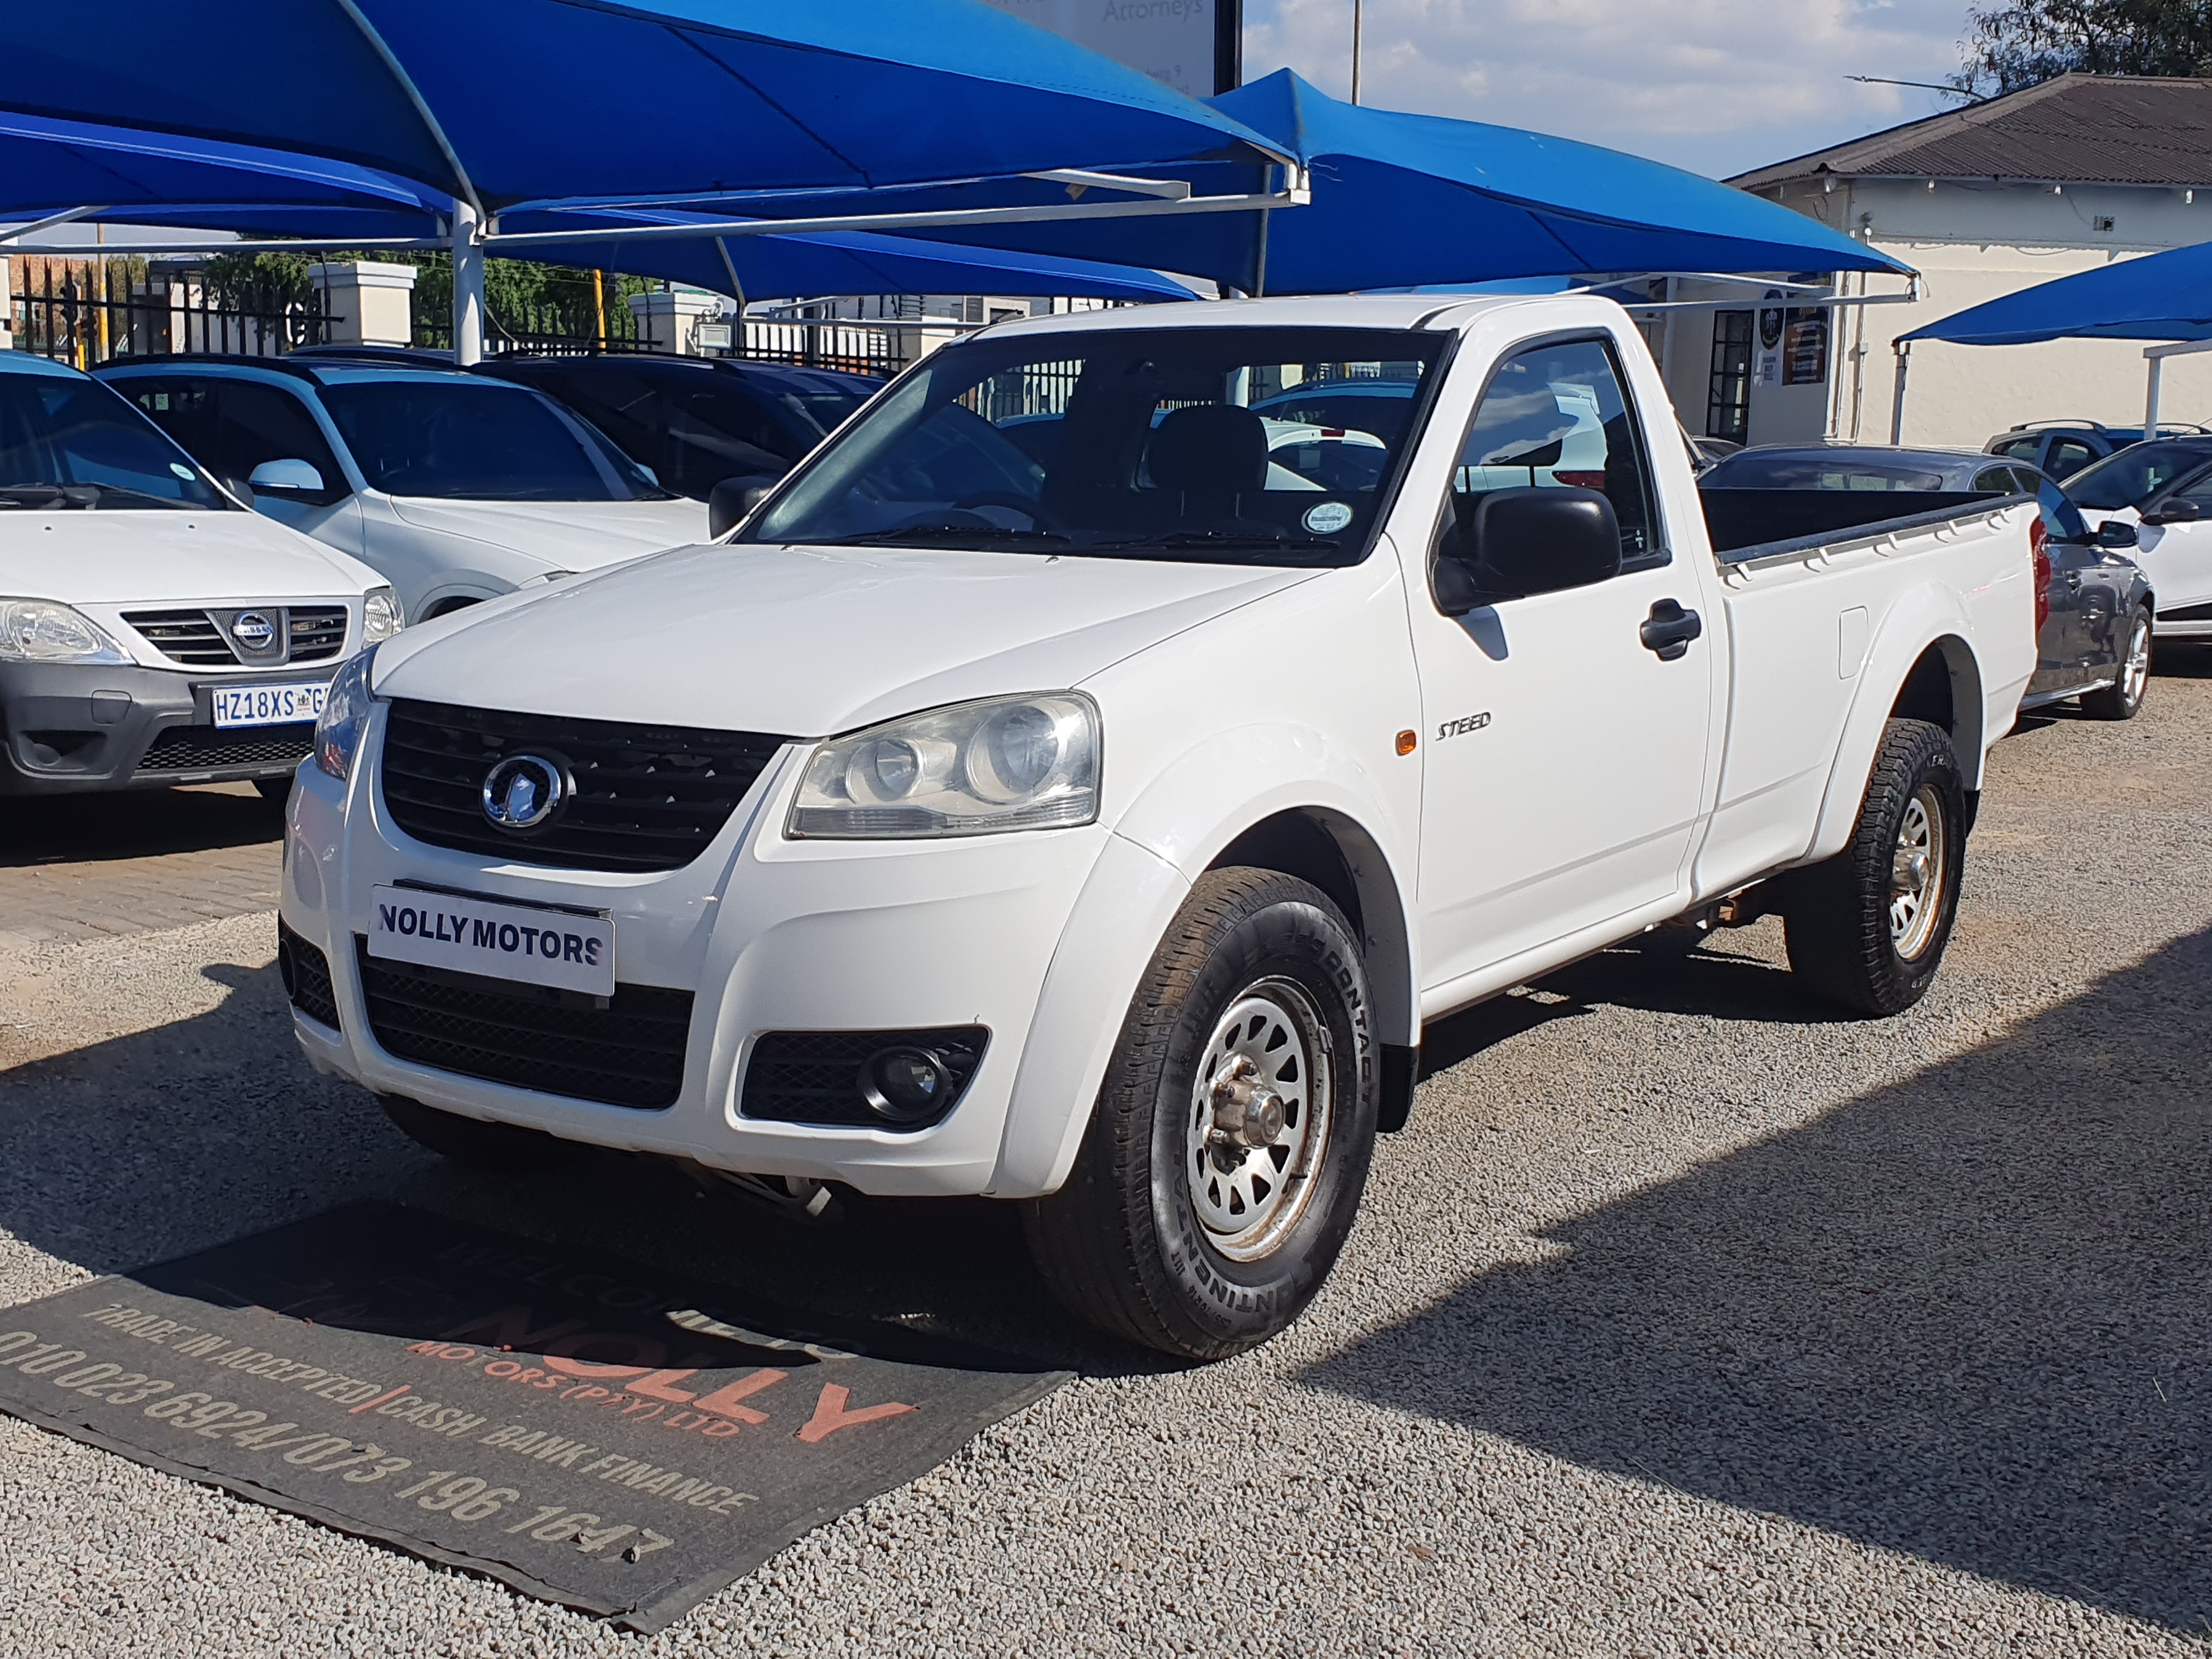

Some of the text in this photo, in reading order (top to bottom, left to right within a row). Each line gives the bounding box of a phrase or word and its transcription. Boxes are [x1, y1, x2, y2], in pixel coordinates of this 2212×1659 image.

[1102, 0, 1203, 22] Attorneys
[216, 690, 294, 721] HZ18XS
[1435, 712, 1491, 741] STEED
[379, 904, 603, 966] NOLLY MOTORS
[439, 1304, 919, 1442] NOLLY
[0, 1330, 87, 1374] 010
[53, 1363, 175, 1404] 023
[394, 1470, 521, 1521] 196
[82, 1303, 198, 1345] TRADE
[171, 1333, 233, 1357] IN
[478, 1425, 600, 1468] BANK
[578, 1453, 759, 1515] FINANCE
